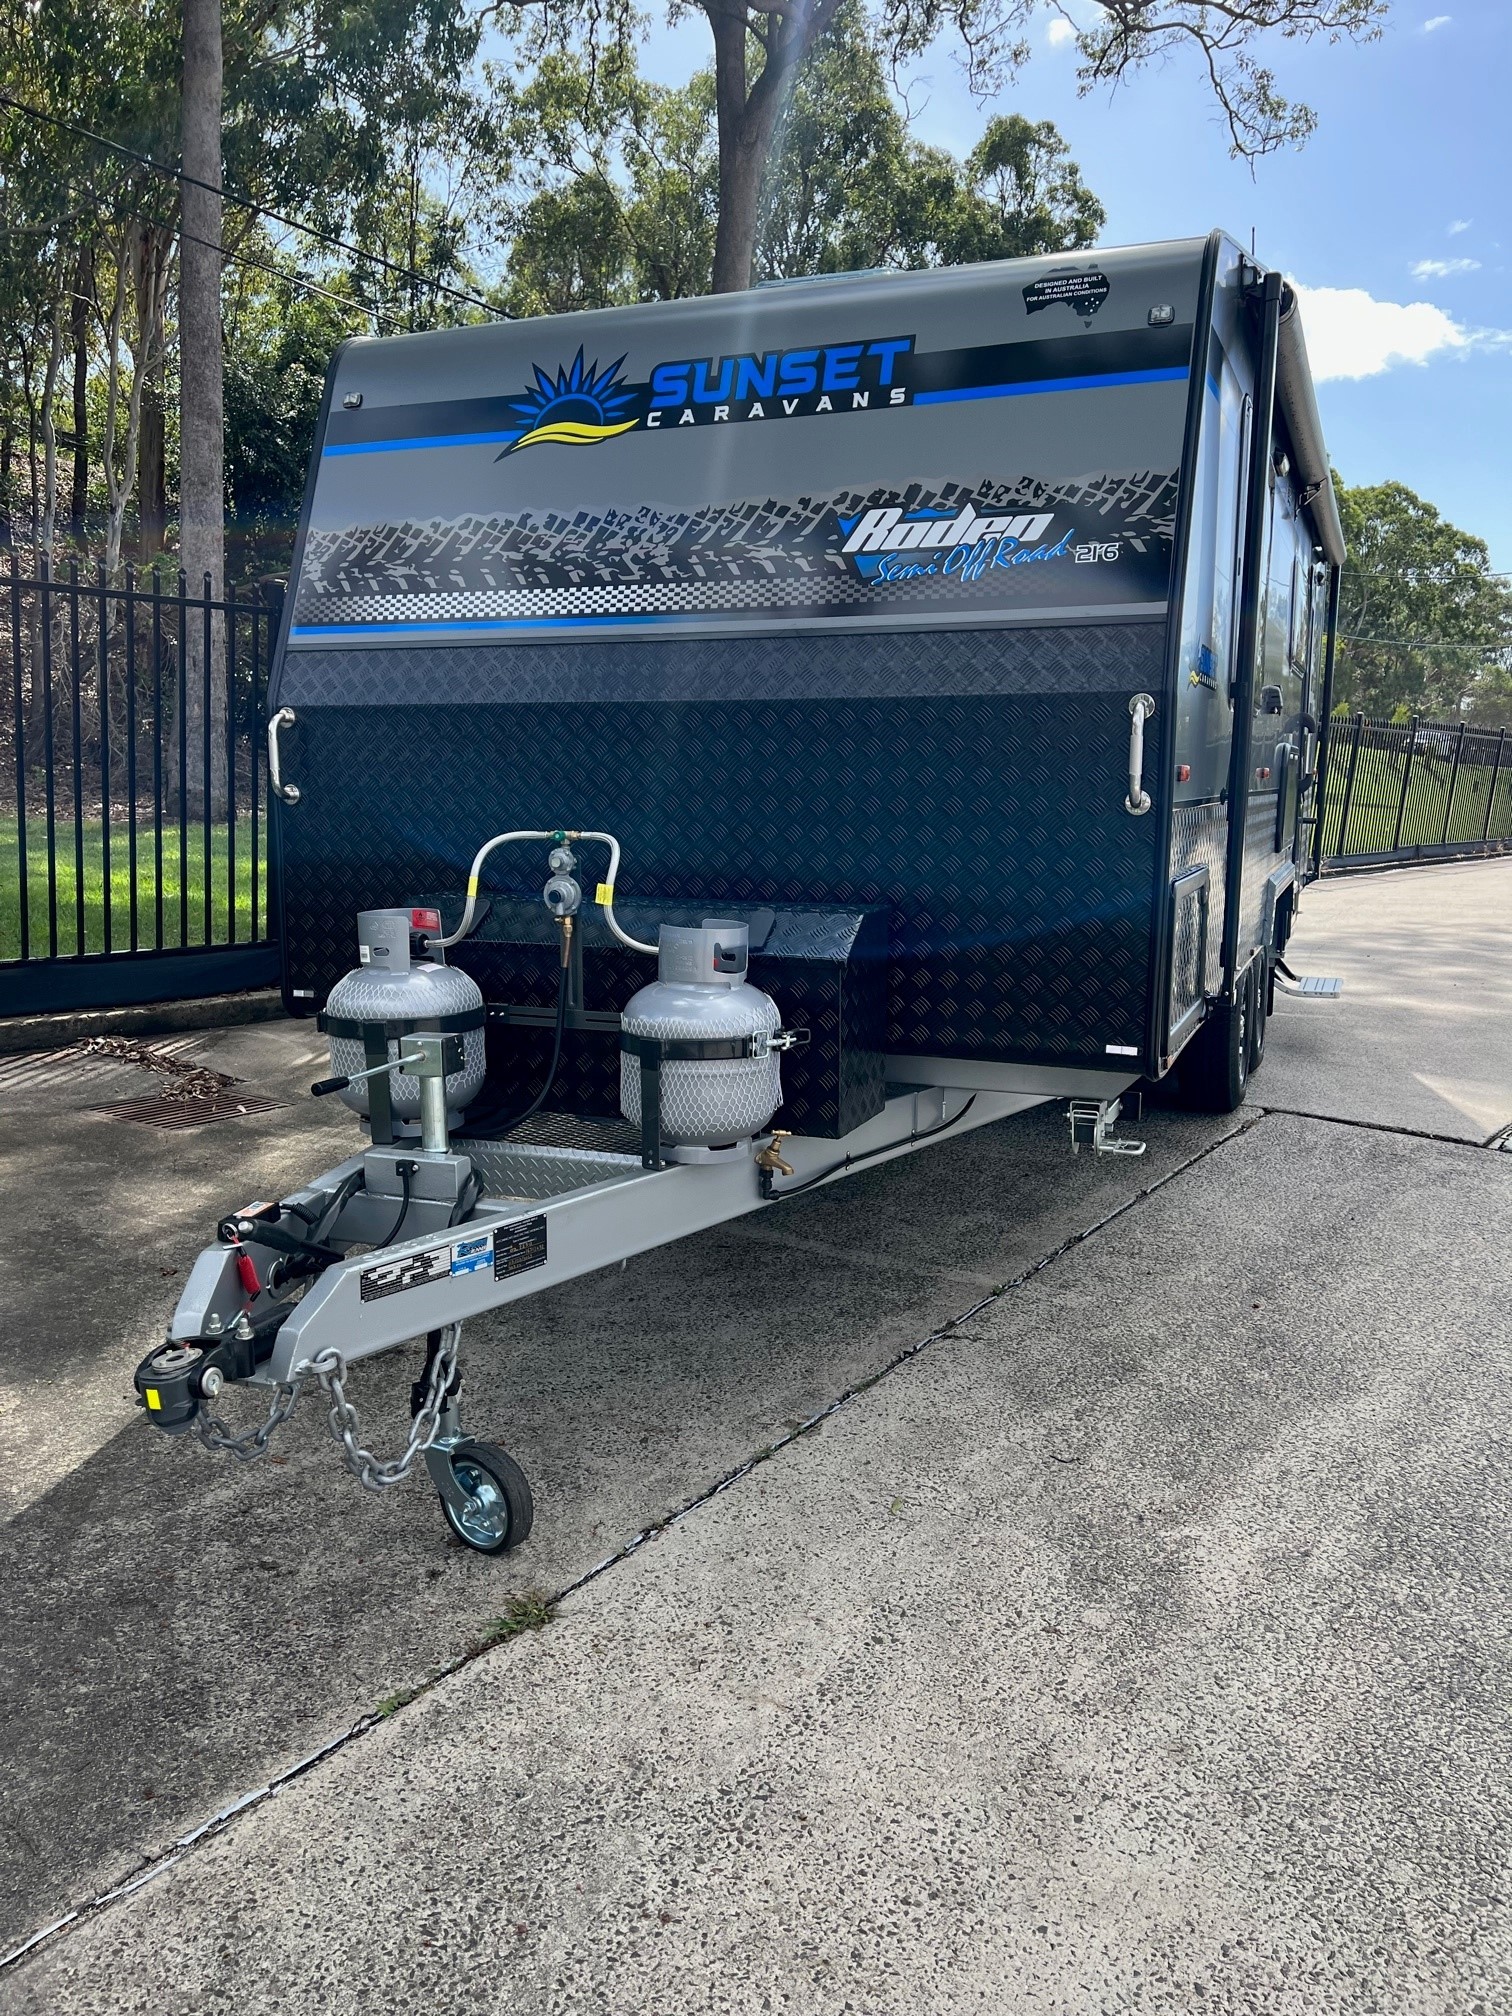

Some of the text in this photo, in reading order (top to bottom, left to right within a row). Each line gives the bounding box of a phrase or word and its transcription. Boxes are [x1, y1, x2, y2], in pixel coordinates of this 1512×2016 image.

[1026, 287, 1107, 302] FOR AUSTRALIAN CONDITIONS
[1035, 280, 1067, 288] DESIGNED
[1052, 283, 1090, 293] AUSTRALIA
[650, 339, 911, 408] SUNSET
[647, 387, 906, 427] CARAVANS
[841, 502, 1055, 553] Rodeo
[870, 528, 1075, 586] Semi Off Road
